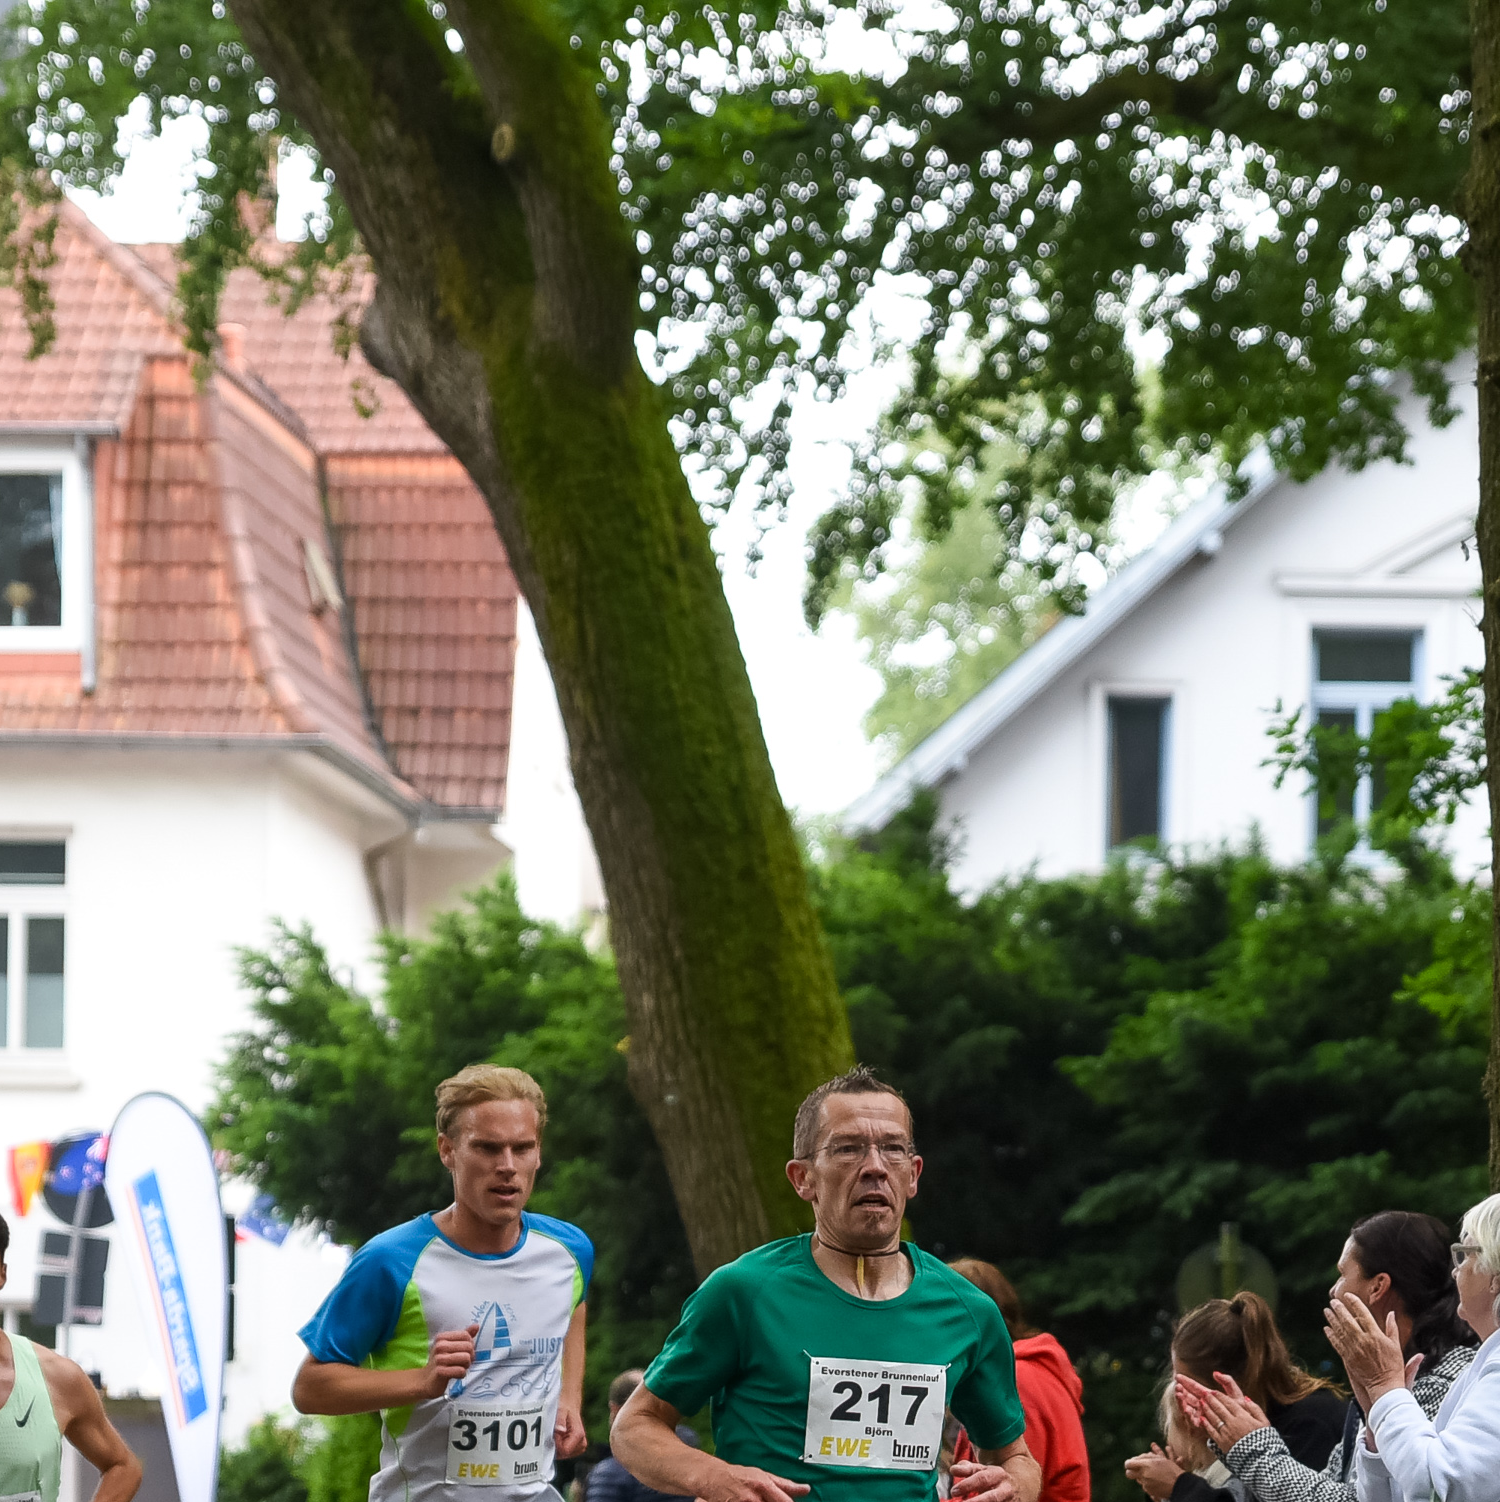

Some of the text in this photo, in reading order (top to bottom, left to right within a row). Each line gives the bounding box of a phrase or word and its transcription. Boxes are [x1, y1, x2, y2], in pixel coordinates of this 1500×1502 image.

[821, 1366, 939, 1383] Everstener Brunnenlauf
[830, 1381, 929, 1426] 217
[457, 1409, 504, 1418] Everstener
[451, 1415, 543, 1452] 3101
[864, 1426, 893, 1438] Björn
[819, 1436, 930, 1459] EWE bruns
[456, 1462, 500, 1478] EWE
[513, 1461, 538, 1475] bruns
